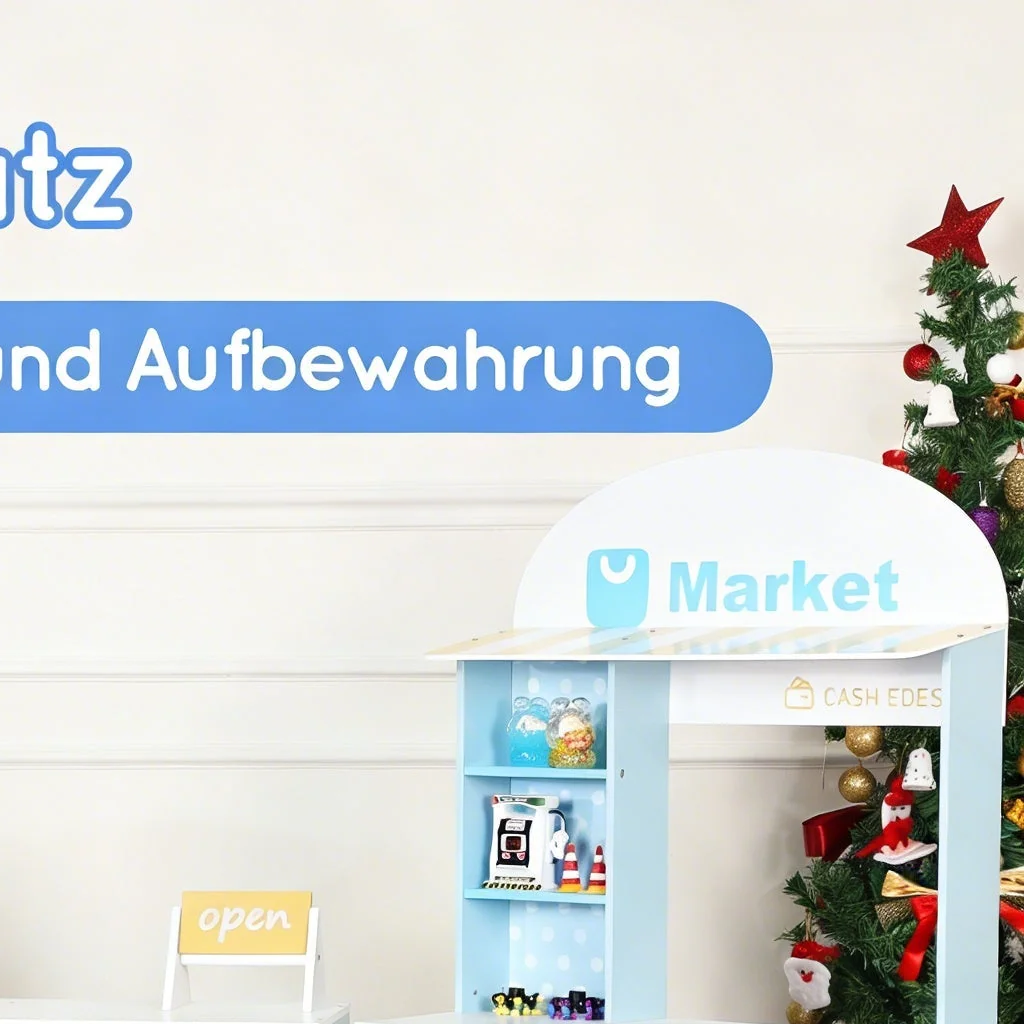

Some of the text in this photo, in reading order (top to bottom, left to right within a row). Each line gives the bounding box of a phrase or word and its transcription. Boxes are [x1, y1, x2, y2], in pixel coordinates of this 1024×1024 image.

[669, 559, 900, 613] Market
[824, 687, 878, 707] CASH
[198, 907, 291, 943] open
